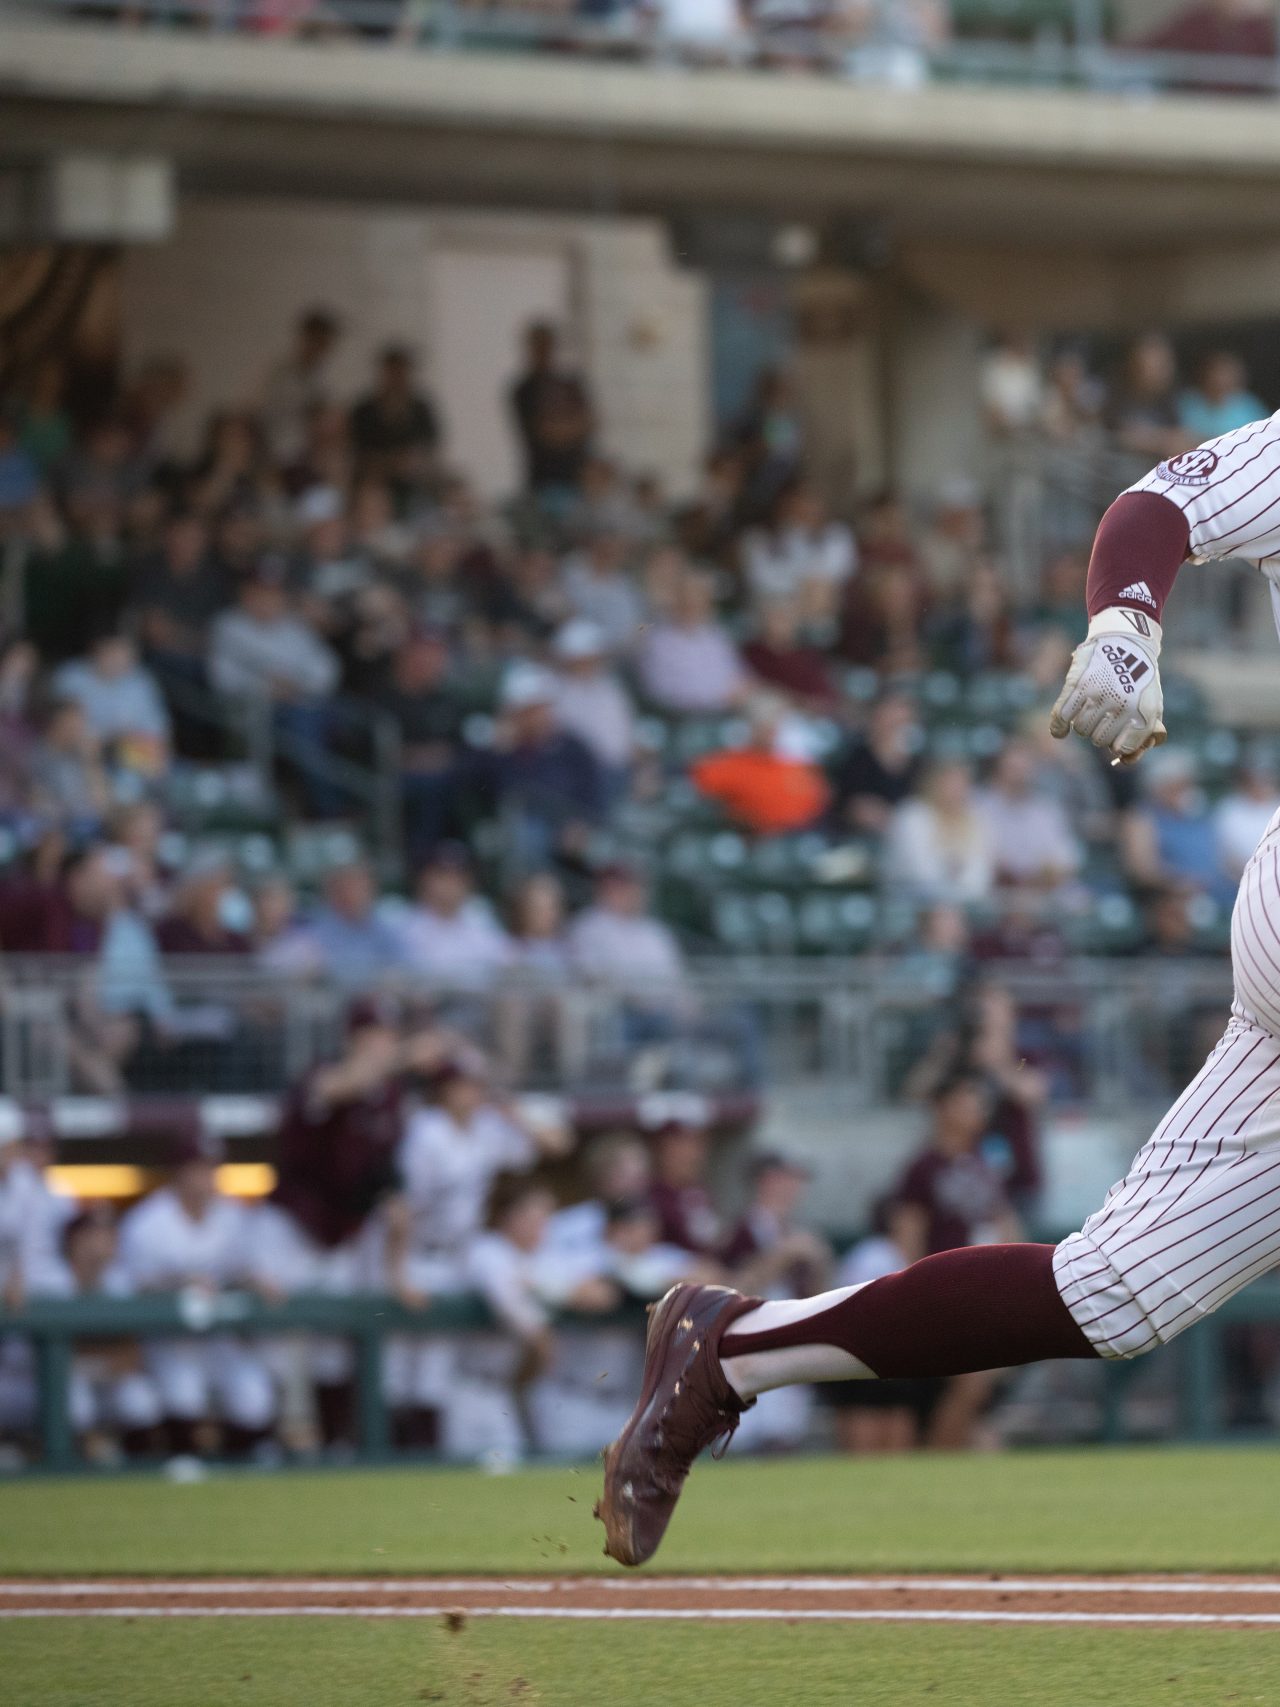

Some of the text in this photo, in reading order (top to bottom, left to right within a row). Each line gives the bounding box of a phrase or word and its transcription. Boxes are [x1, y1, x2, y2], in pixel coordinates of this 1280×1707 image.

[1171, 451, 1216, 477] SEC
[1118, 590, 1157, 609] adidas
[1101, 644, 1135, 694] adidas
